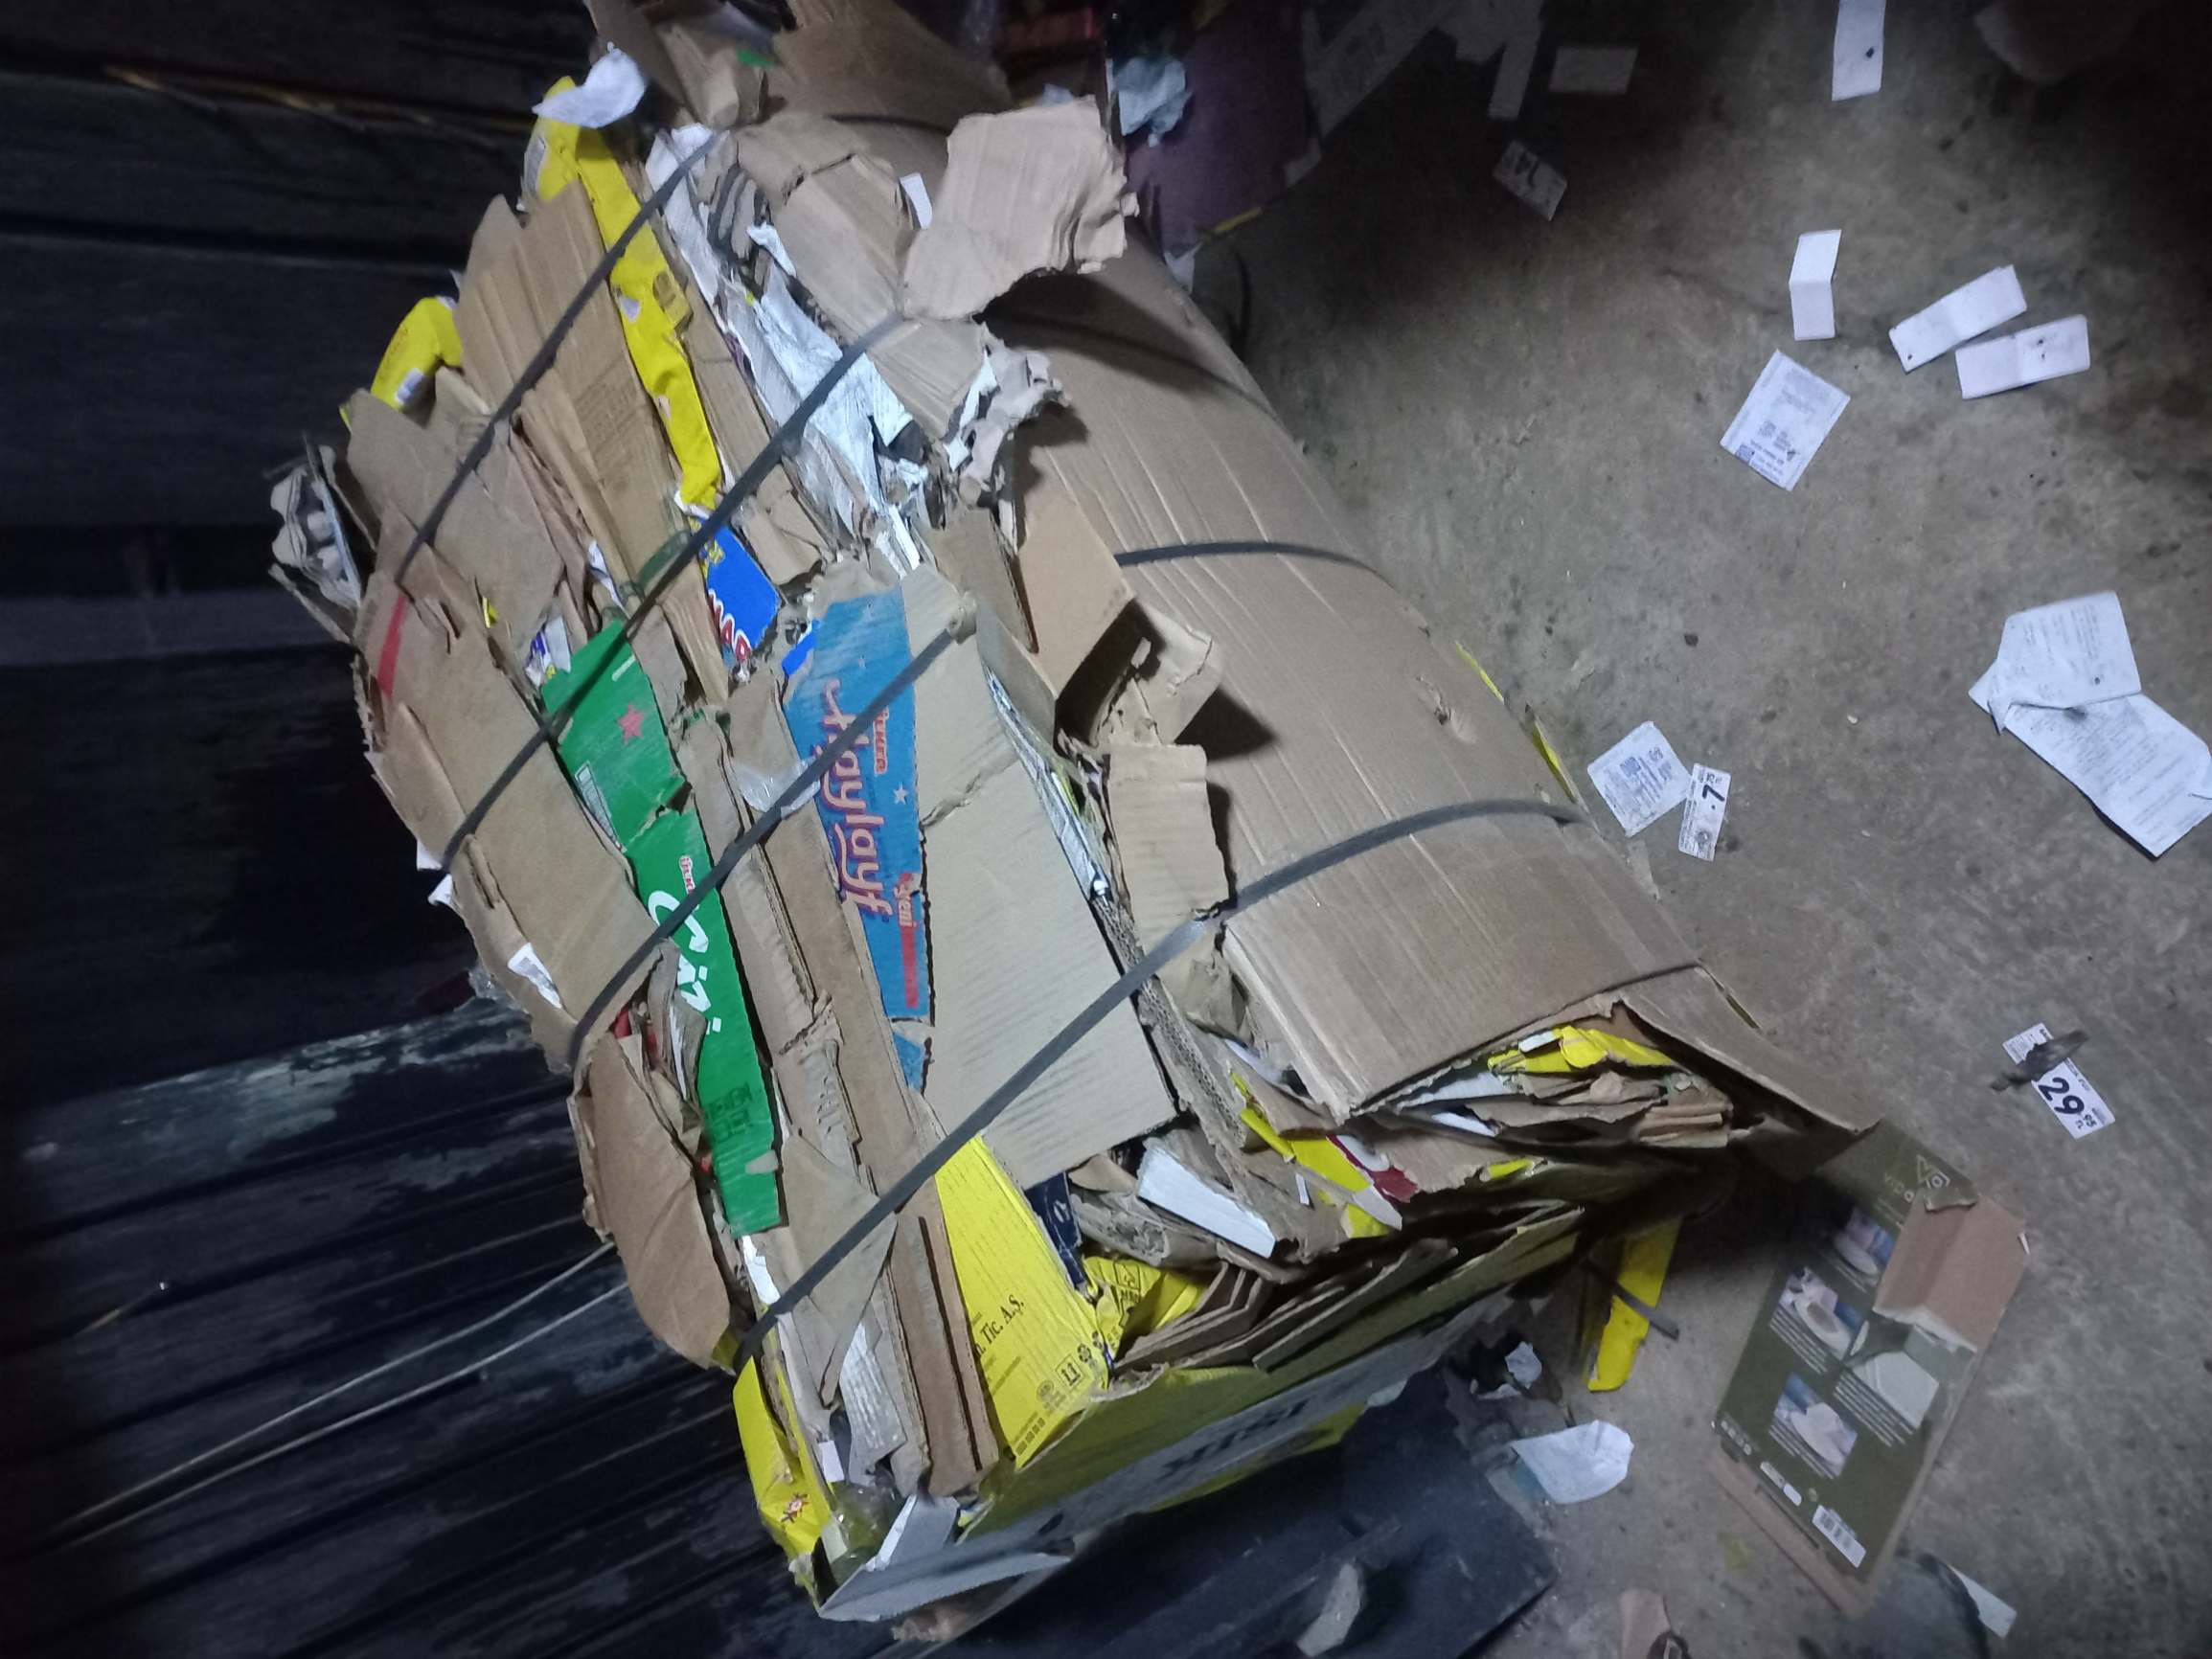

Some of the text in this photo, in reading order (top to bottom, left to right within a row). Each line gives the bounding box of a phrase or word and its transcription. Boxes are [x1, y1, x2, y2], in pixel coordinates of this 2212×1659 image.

[2037, 1077, 2086, 1115] 29
[979, 1320, 1004, 1345] Tic.
[1000, 1293, 1025, 1325] A.Ş.
